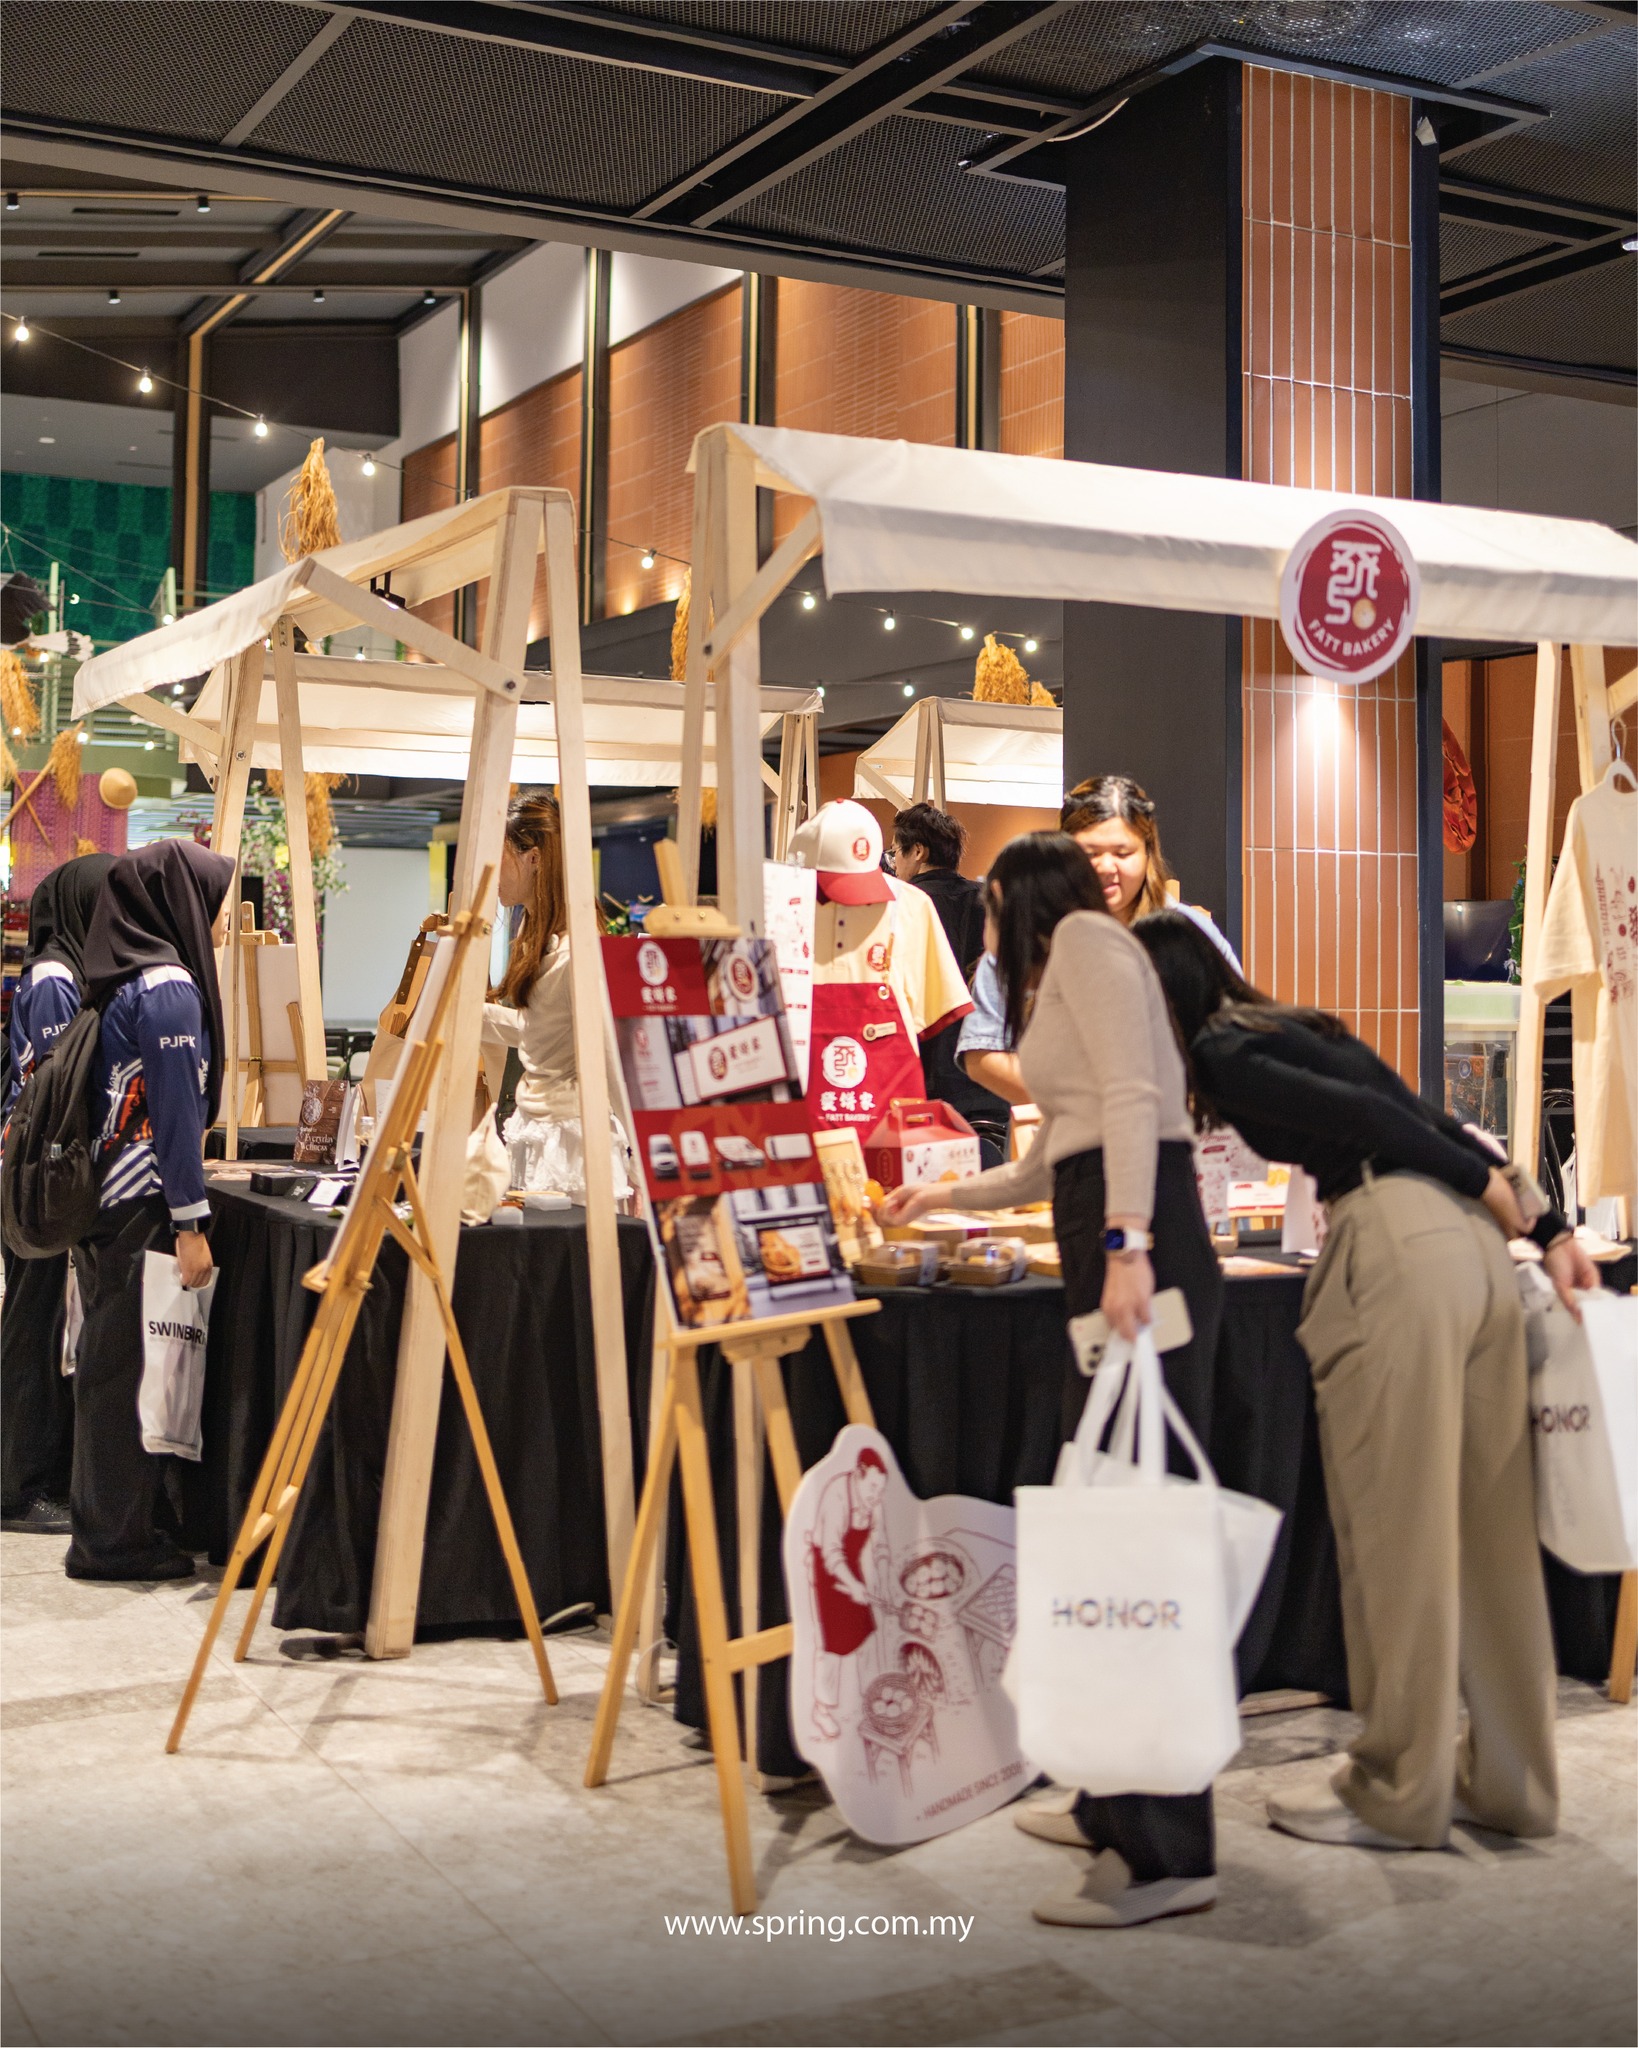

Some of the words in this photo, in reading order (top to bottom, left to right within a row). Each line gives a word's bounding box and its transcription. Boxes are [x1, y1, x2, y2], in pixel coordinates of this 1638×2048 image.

[1308, 618, 1342, 653] FATT
[1342, 617, 1394, 657] BAKERY
[42, 1023, 69, 1038] PJP
[159, 1035, 196, 1049] PJPK
[304, 1134, 334, 1145] Everyday
[149, 1320, 207, 1345] SWINBR
[1052, 1597, 1182, 1630] HONOR
[923, 1783, 973, 1817] HANDMADE
